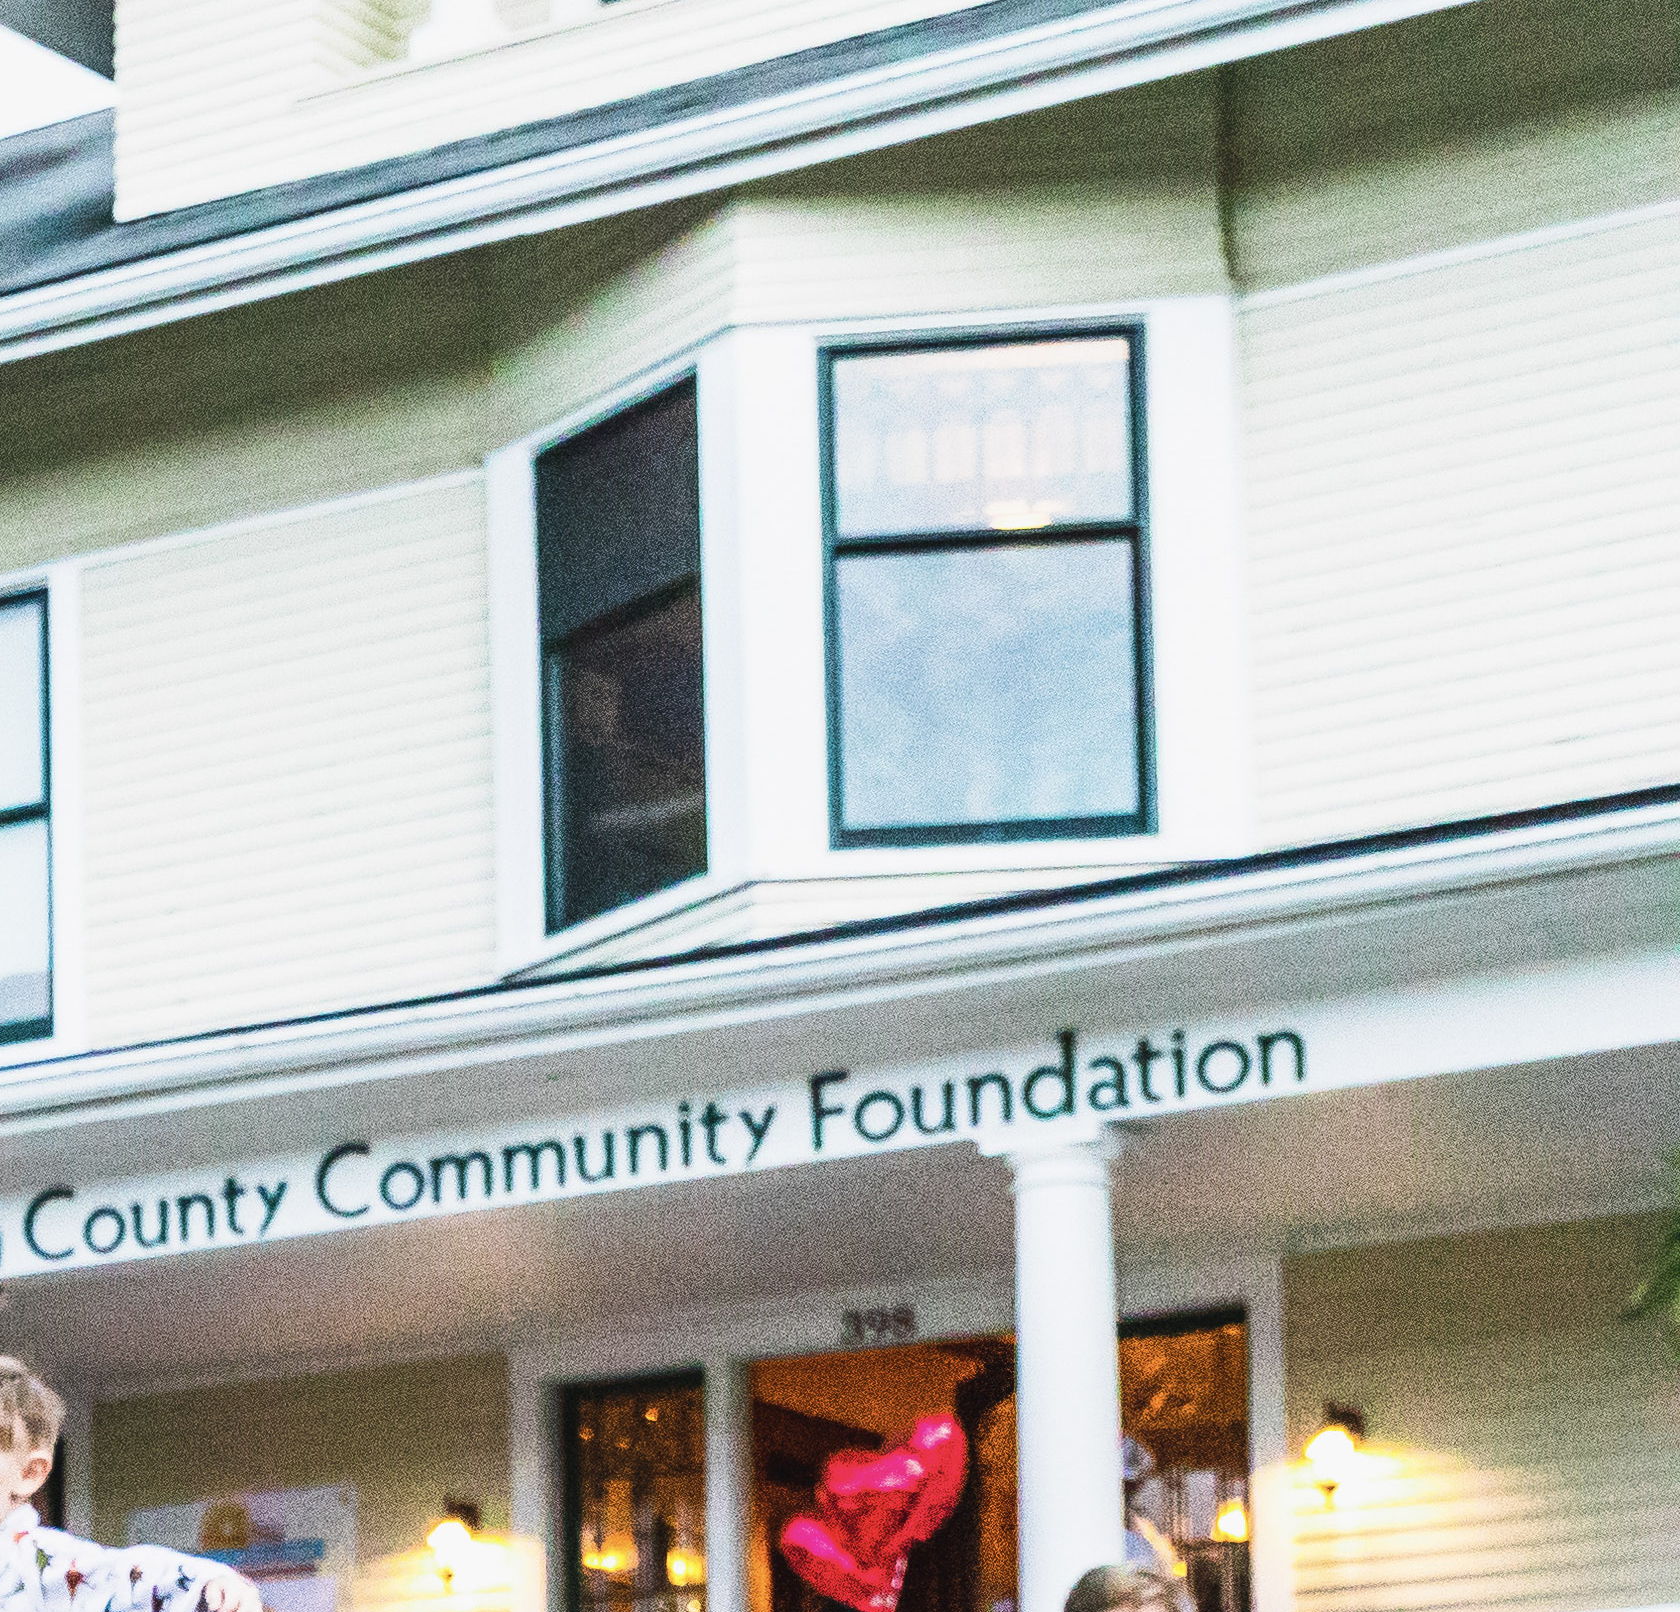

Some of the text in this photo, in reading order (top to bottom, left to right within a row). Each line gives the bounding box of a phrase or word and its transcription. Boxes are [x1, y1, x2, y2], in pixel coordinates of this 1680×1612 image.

[22, 1176, 288, 1261] County
[314, 1096, 776, 1220] Community
[808, 1029, 1307, 1151] Foundation
